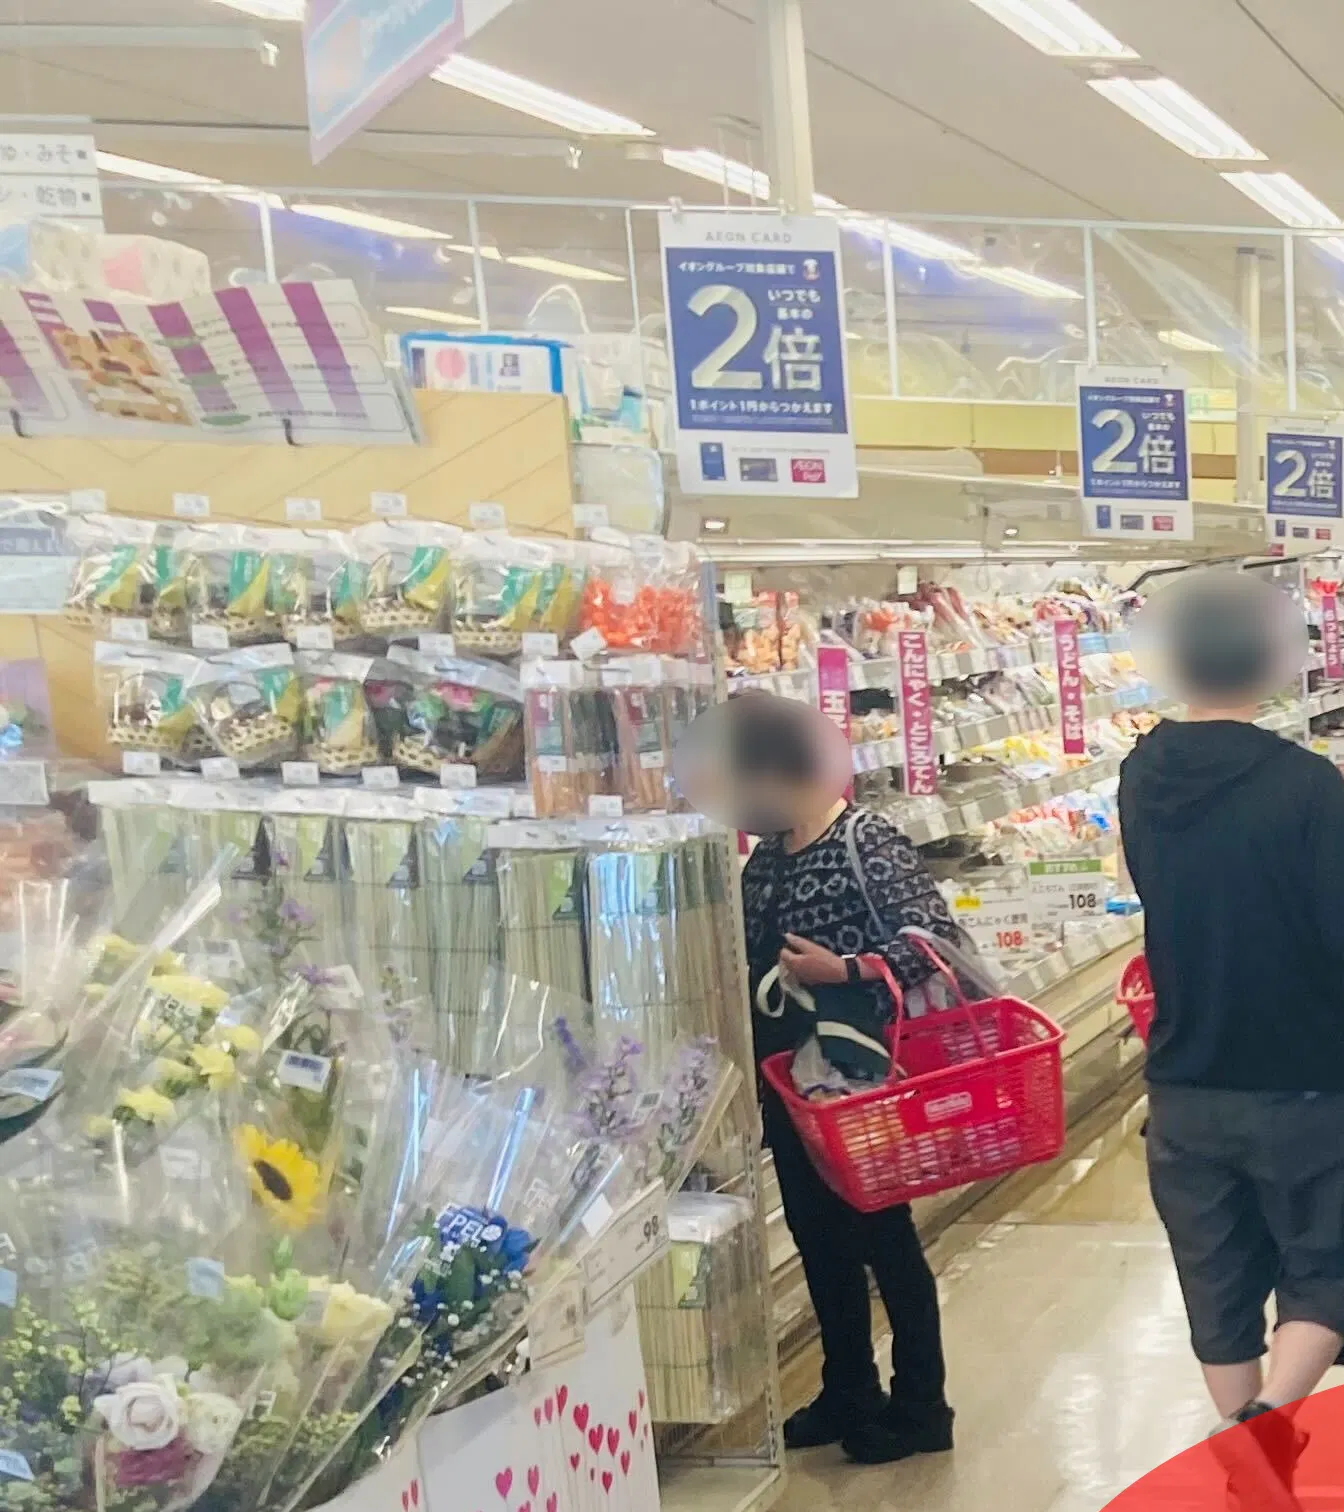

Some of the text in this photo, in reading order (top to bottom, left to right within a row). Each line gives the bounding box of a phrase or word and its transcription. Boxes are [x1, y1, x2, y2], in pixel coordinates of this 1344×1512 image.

[705, 231, 792, 244] AEON CARD
[768, 289, 821, 303] いつでも
[777, 307, 813, 321] 基本の
[689, 398, 833, 415] 1ポイント1円からつかえます
[1068, 892, 1098, 909] 108
[995, 930, 1024, 949] 108
